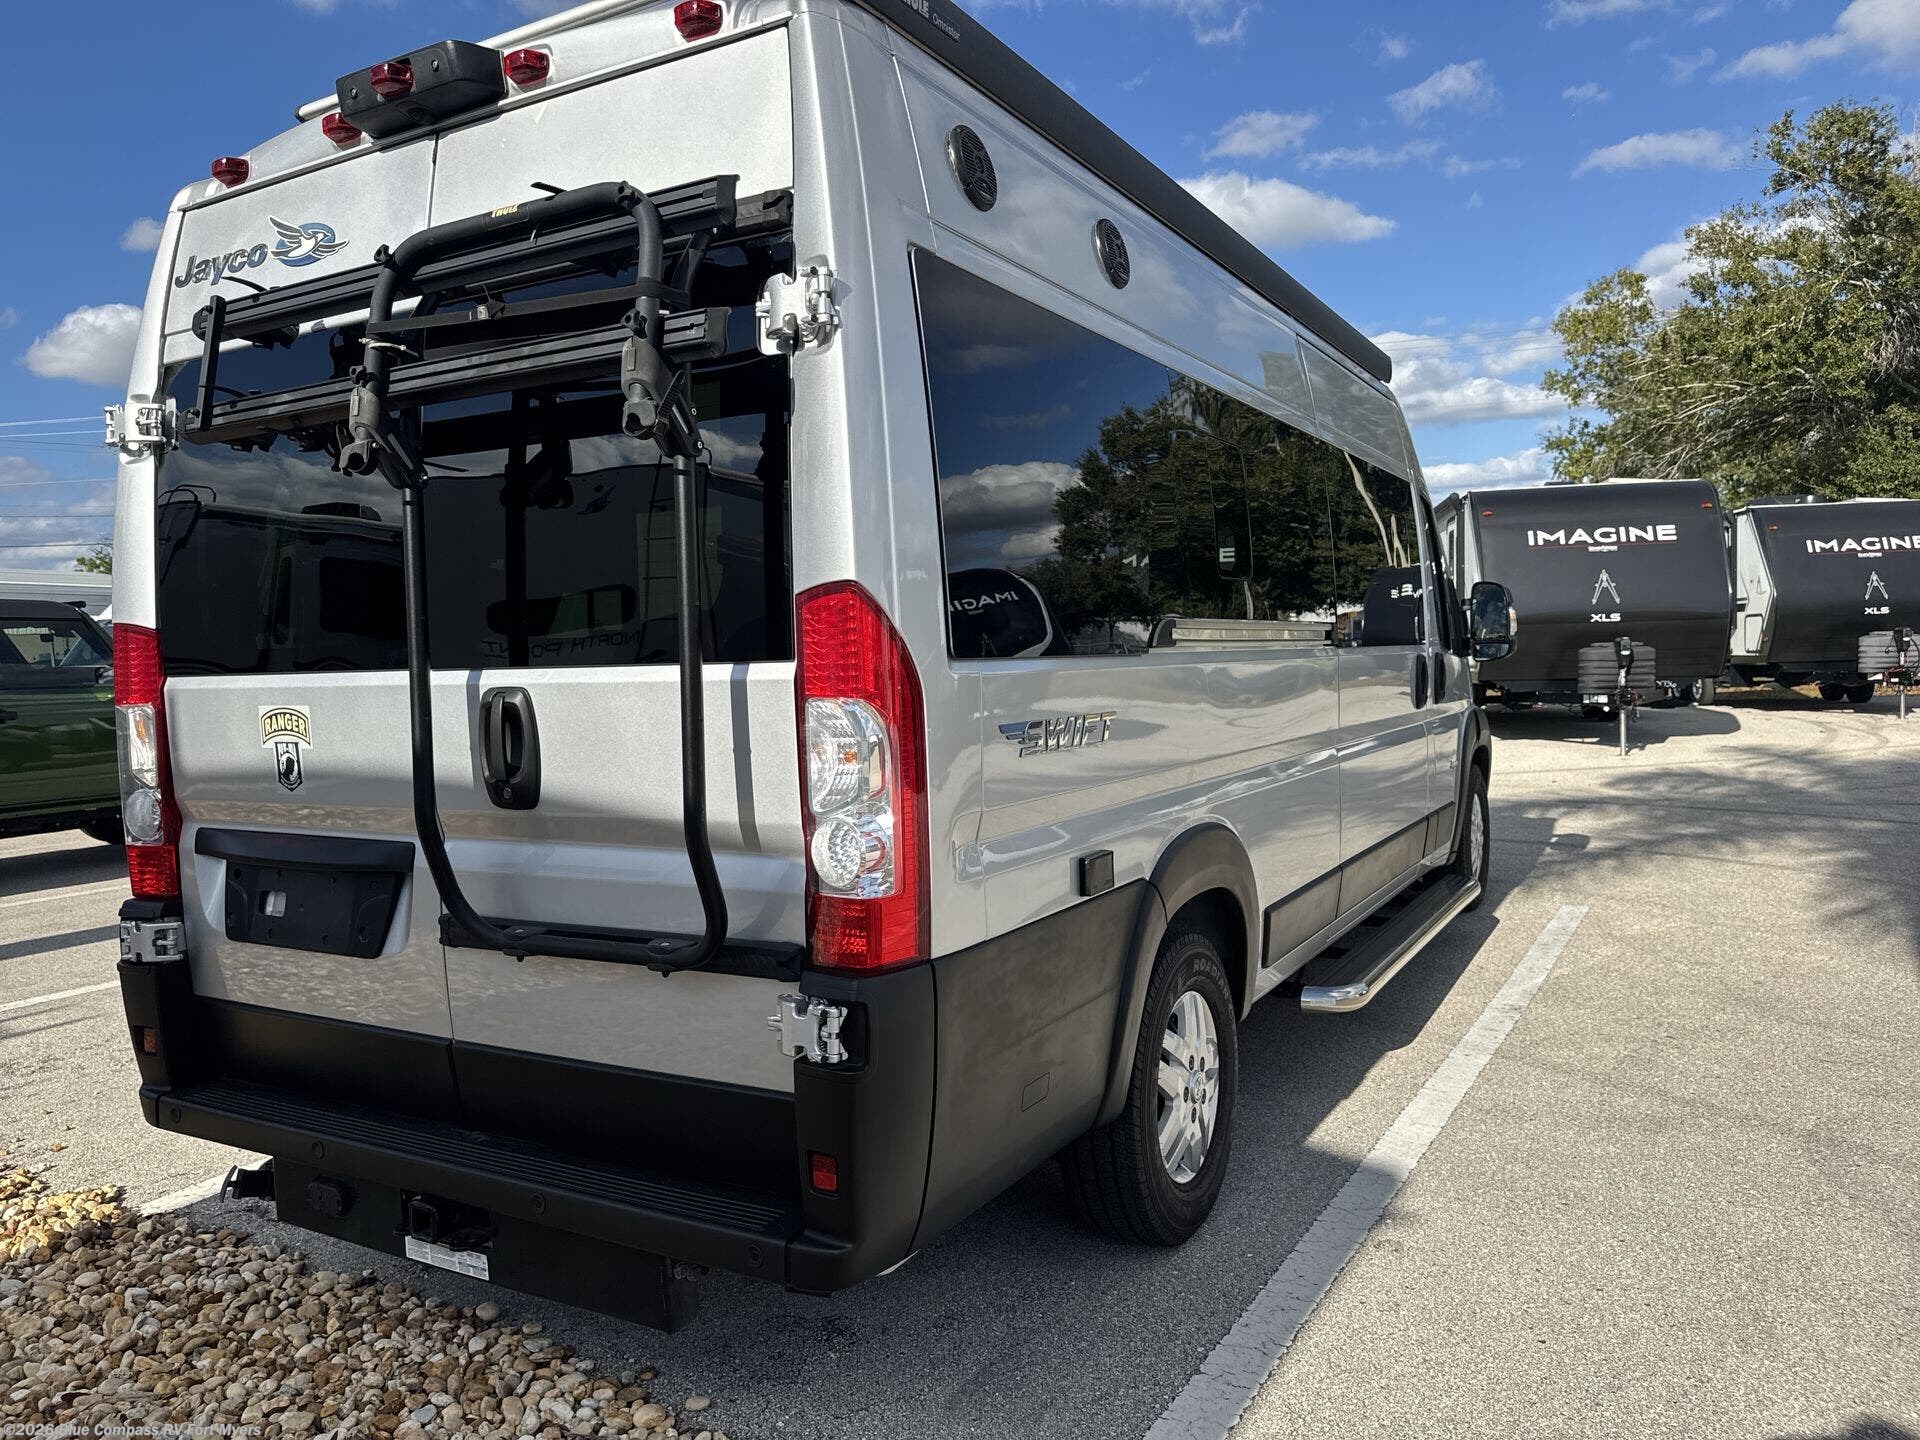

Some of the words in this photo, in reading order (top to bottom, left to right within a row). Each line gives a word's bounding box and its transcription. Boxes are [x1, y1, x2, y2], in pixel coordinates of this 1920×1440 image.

[174, 243, 269, 289] Jayco
[1527, 524, 1678, 546] IMAGINE
[1590, 613, 1622, 622] XLS
[1864, 606, 1890, 615] XLS
[263, 713, 307, 738] RANGER
[1018, 710, 1117, 757] SWIFT
